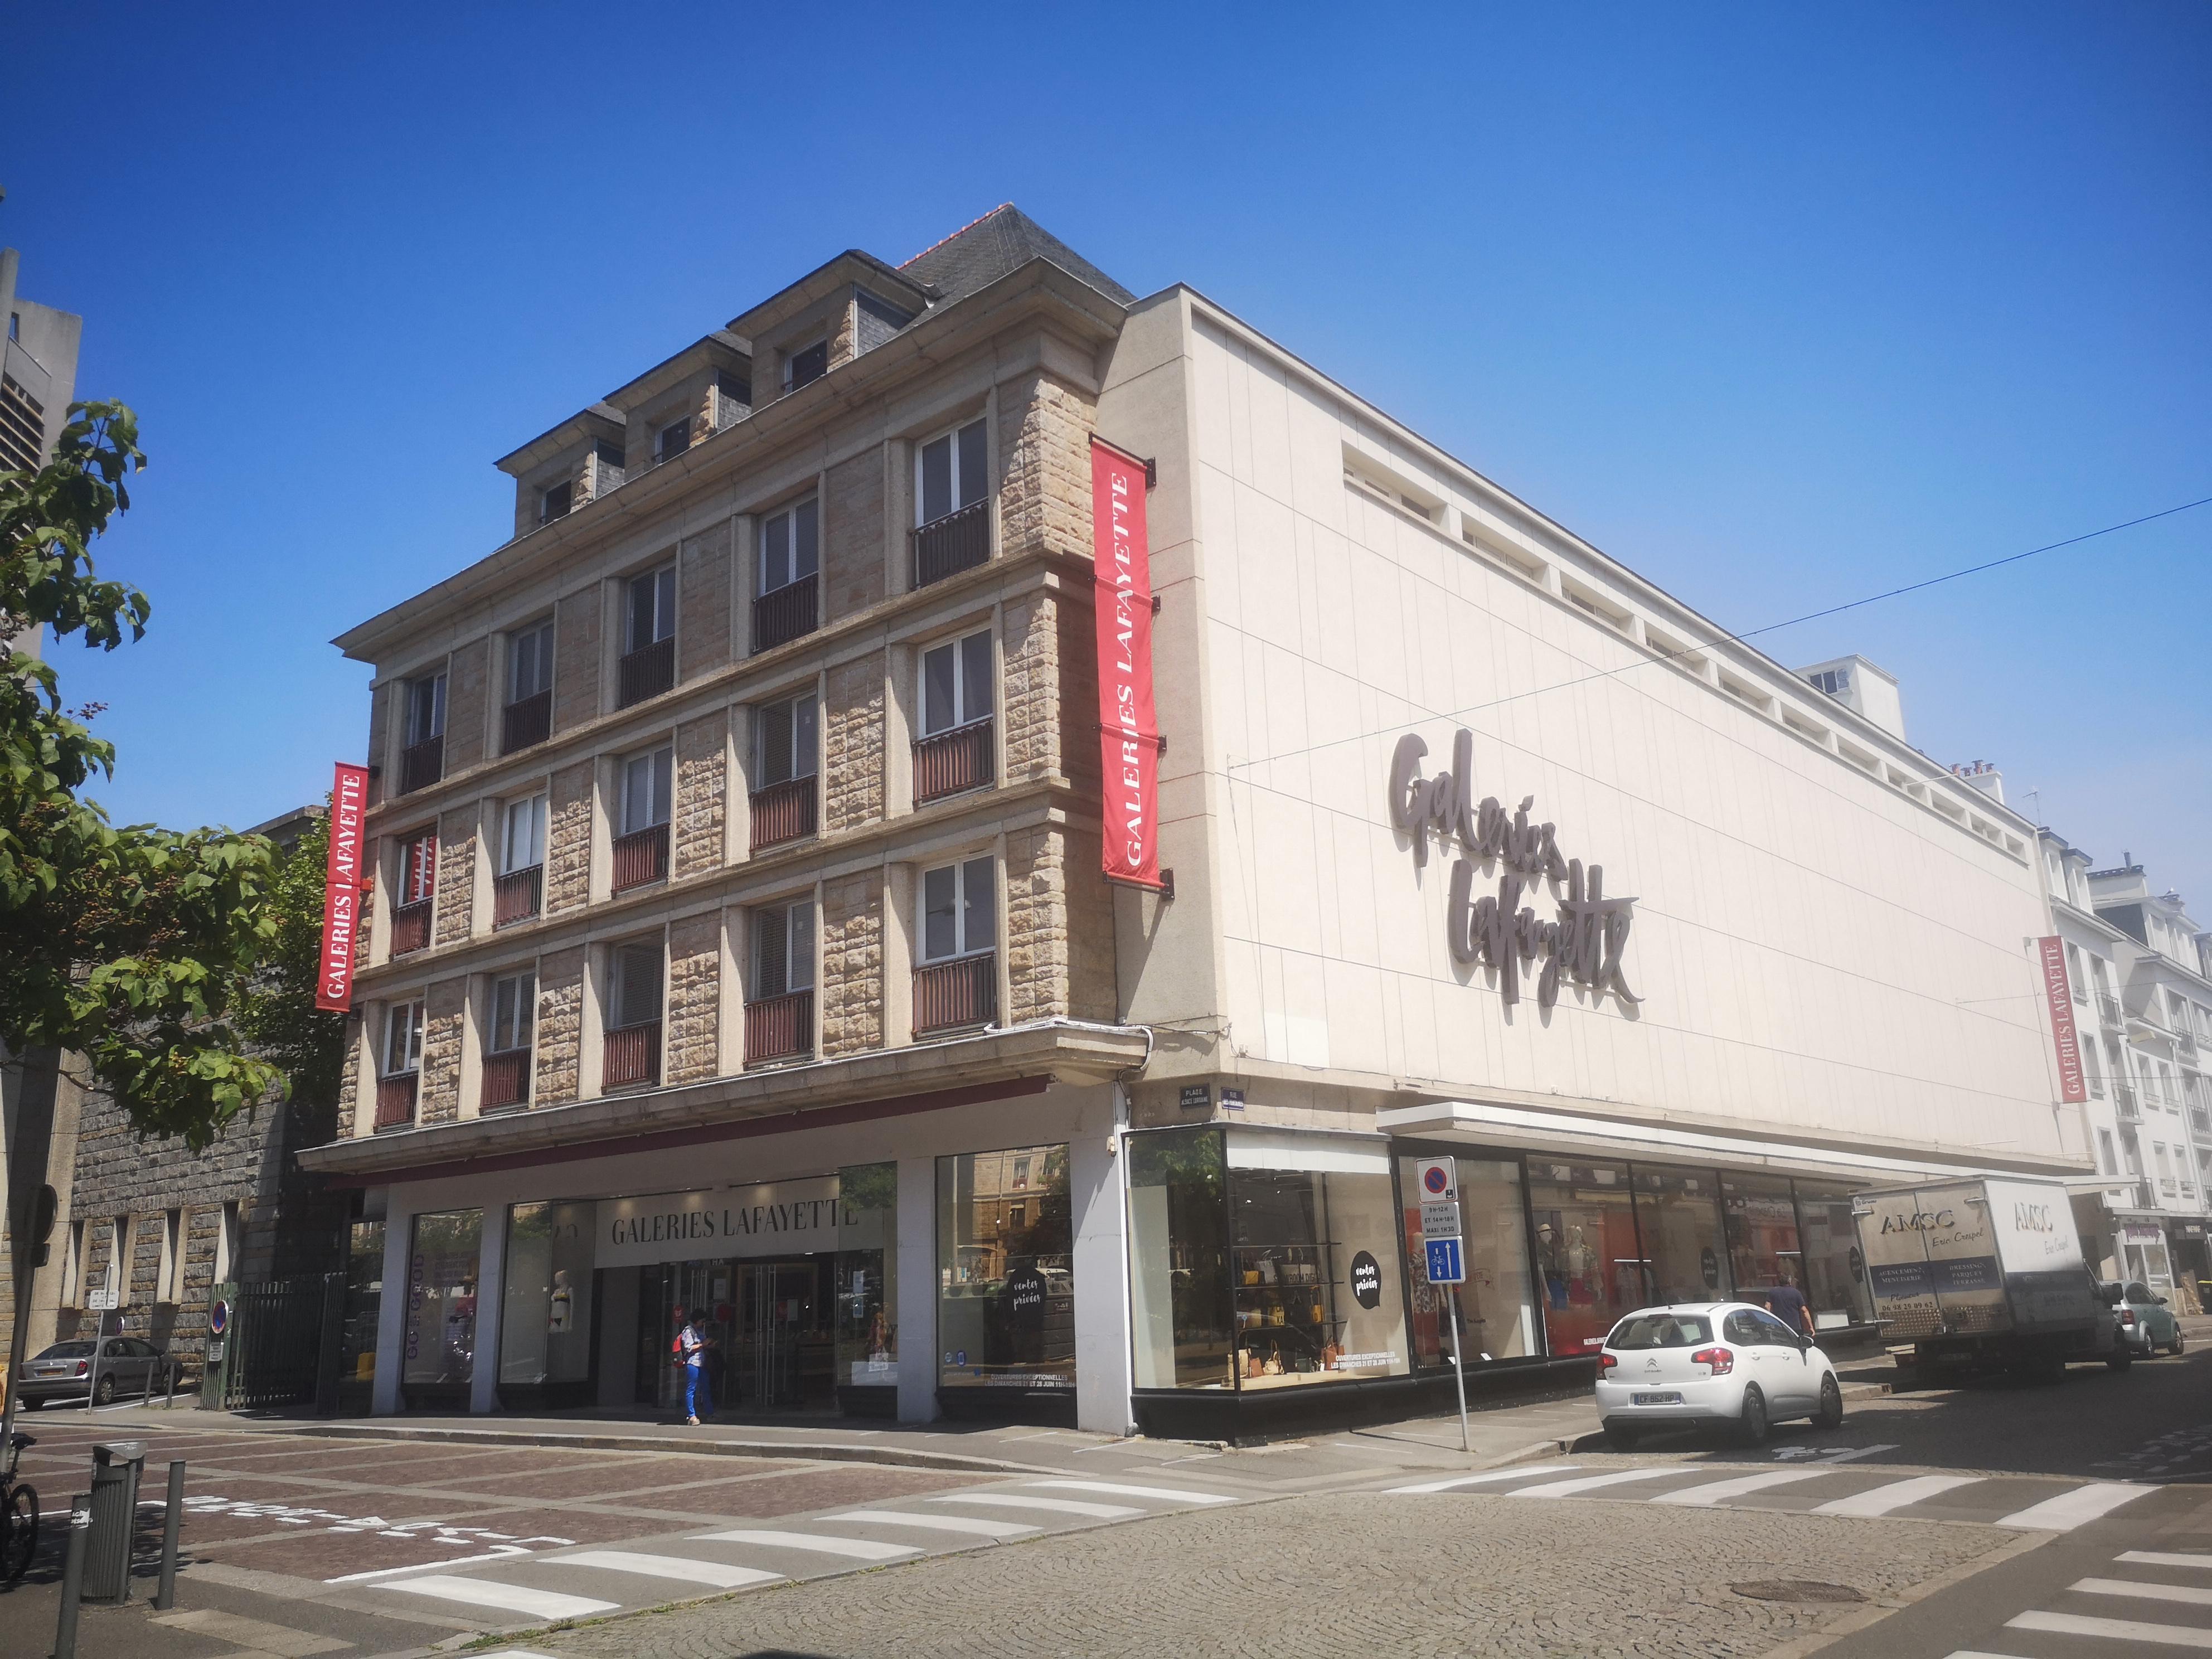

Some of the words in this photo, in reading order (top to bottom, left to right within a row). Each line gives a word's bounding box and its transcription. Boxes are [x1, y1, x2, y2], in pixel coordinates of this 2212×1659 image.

[1112, 473, 1133, 673] LAFAYETTE
[1118, 683, 1143, 866] GALERIES
[335, 774, 360, 890] LAFAYETTE
[327, 895, 351, 998] GALERIES
[2045, 944, 2070, 1022] LAFAYETTE
[2060, 1026, 2080, 1094] GALERIES
[612, 1211, 714, 1245] GALERIES
[724, 1199, 858, 1236] LAFAYETTE
[1013, 1292, 1041, 1311] privées
[1014, 1279, 1038, 1291] ventes
[1356, 1264, 1375, 1276] ventes
[1356, 1277, 1378, 1297] privées
